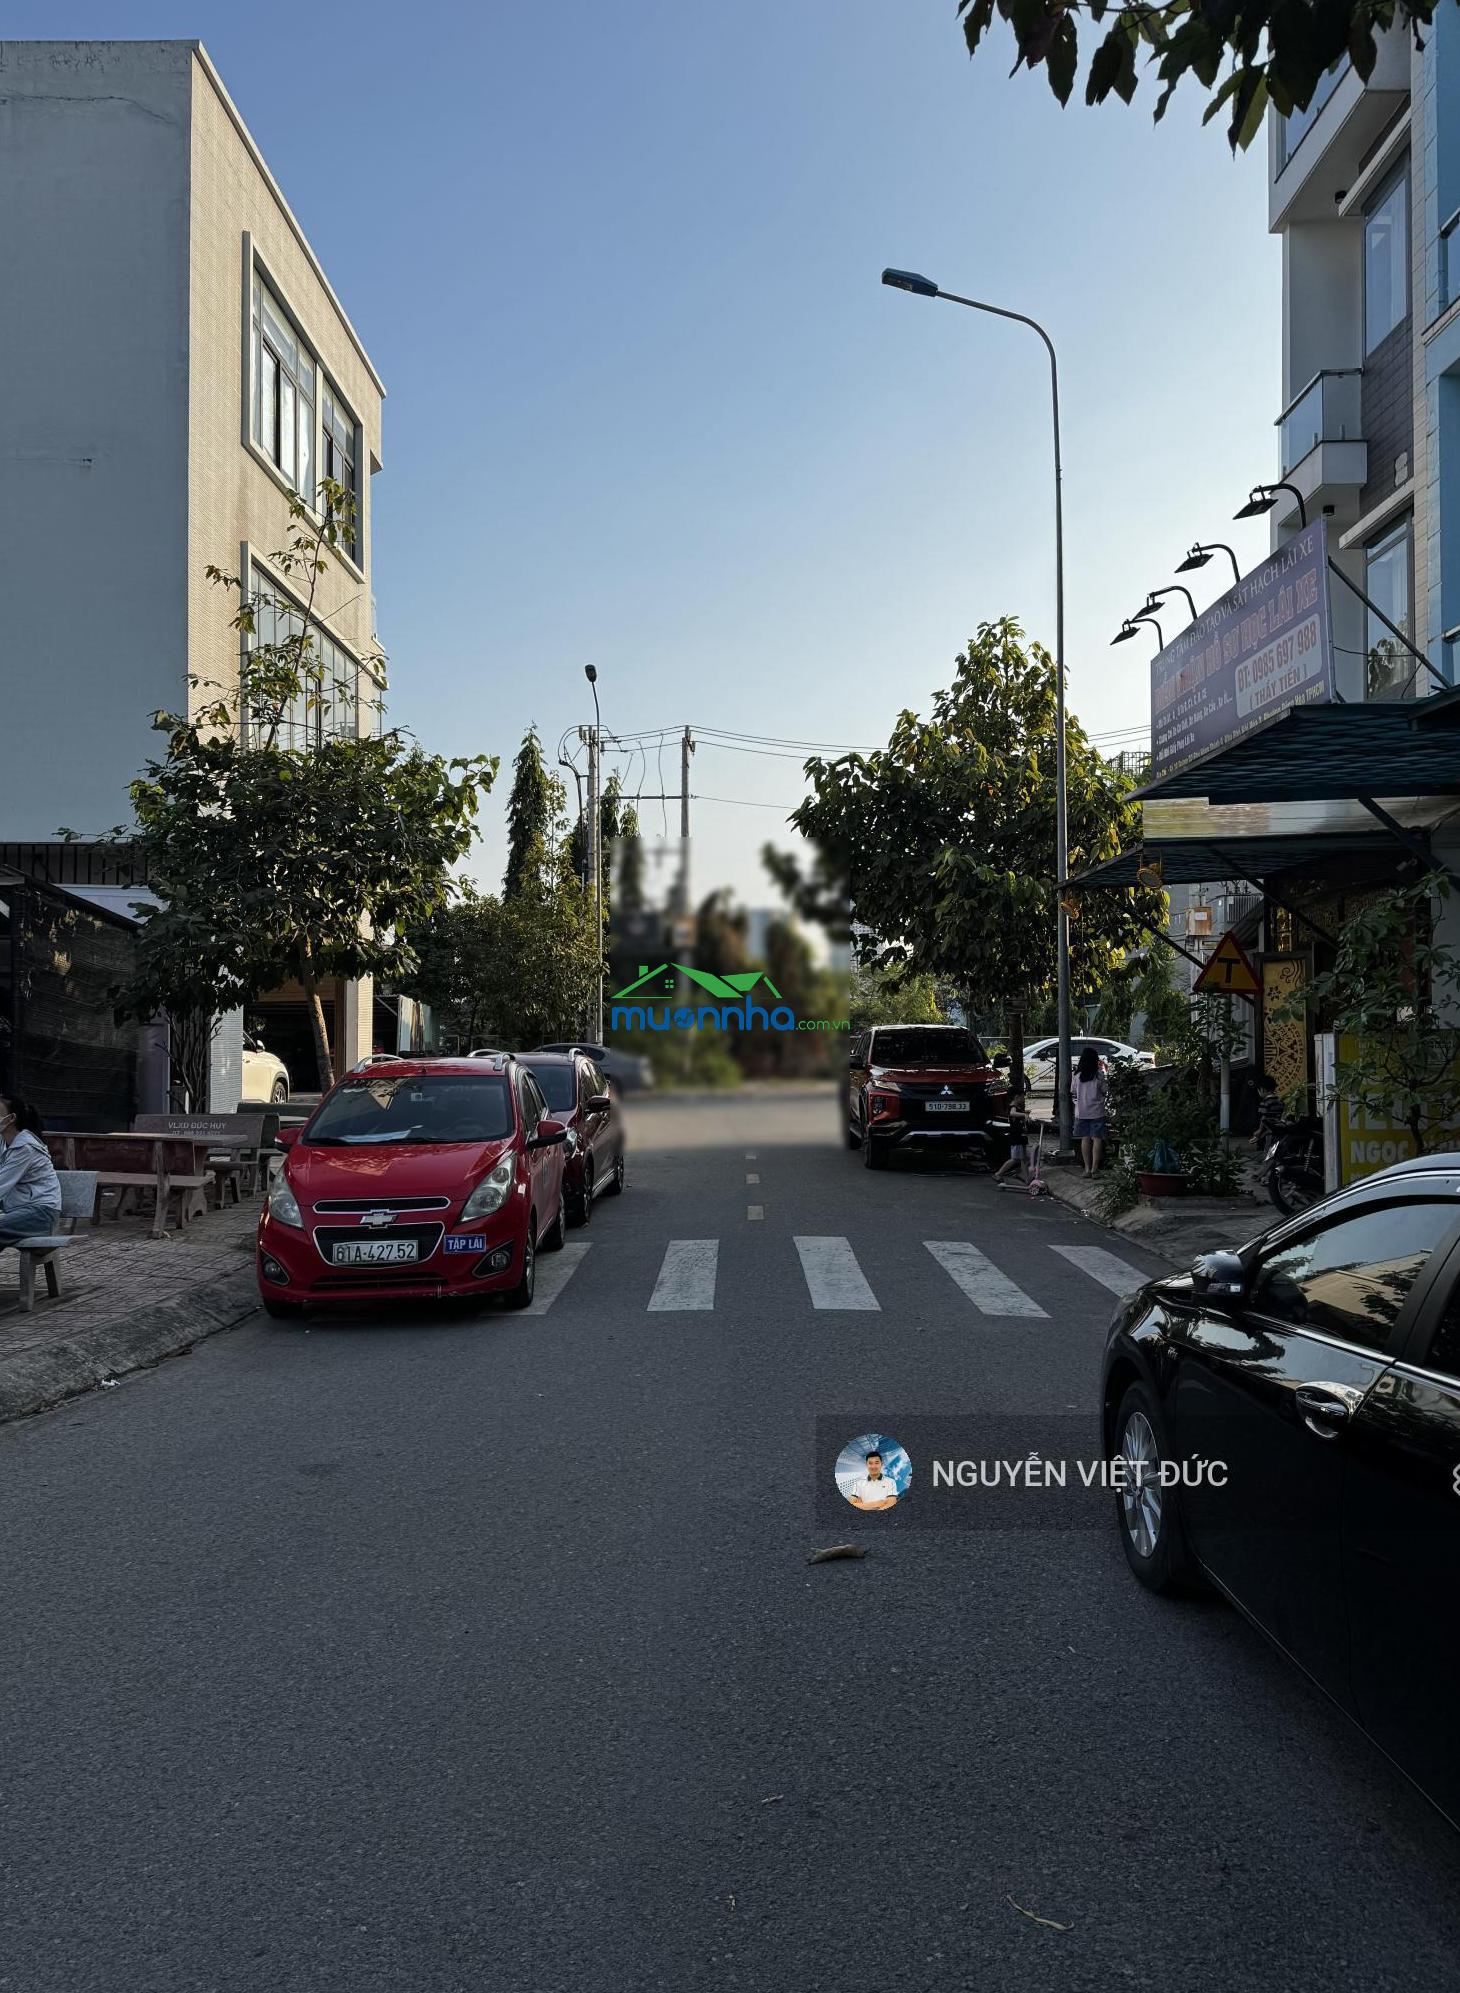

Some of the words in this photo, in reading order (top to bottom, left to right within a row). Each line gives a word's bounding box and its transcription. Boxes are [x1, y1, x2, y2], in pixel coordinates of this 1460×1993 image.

[1232, 585, 1249, 612] SÁT
[1250, 562, 1279, 598] HẠCH
[1281, 547, 1297, 573] LÁI
[1300, 535, 1314, 560] XE
[1295, 567, 1318, 614] XE
[1253, 649, 1275, 682] 0985
[1276, 634, 1294, 668] 697
[1297, 620, 1317, 656] 988
[210, 1121, 226, 1129] HUY
[336, 1242, 415, 1264] 61A-427.52
[448, 1237, 467, 1253] TẬP
[468, 1235, 483, 1249] LÁI
